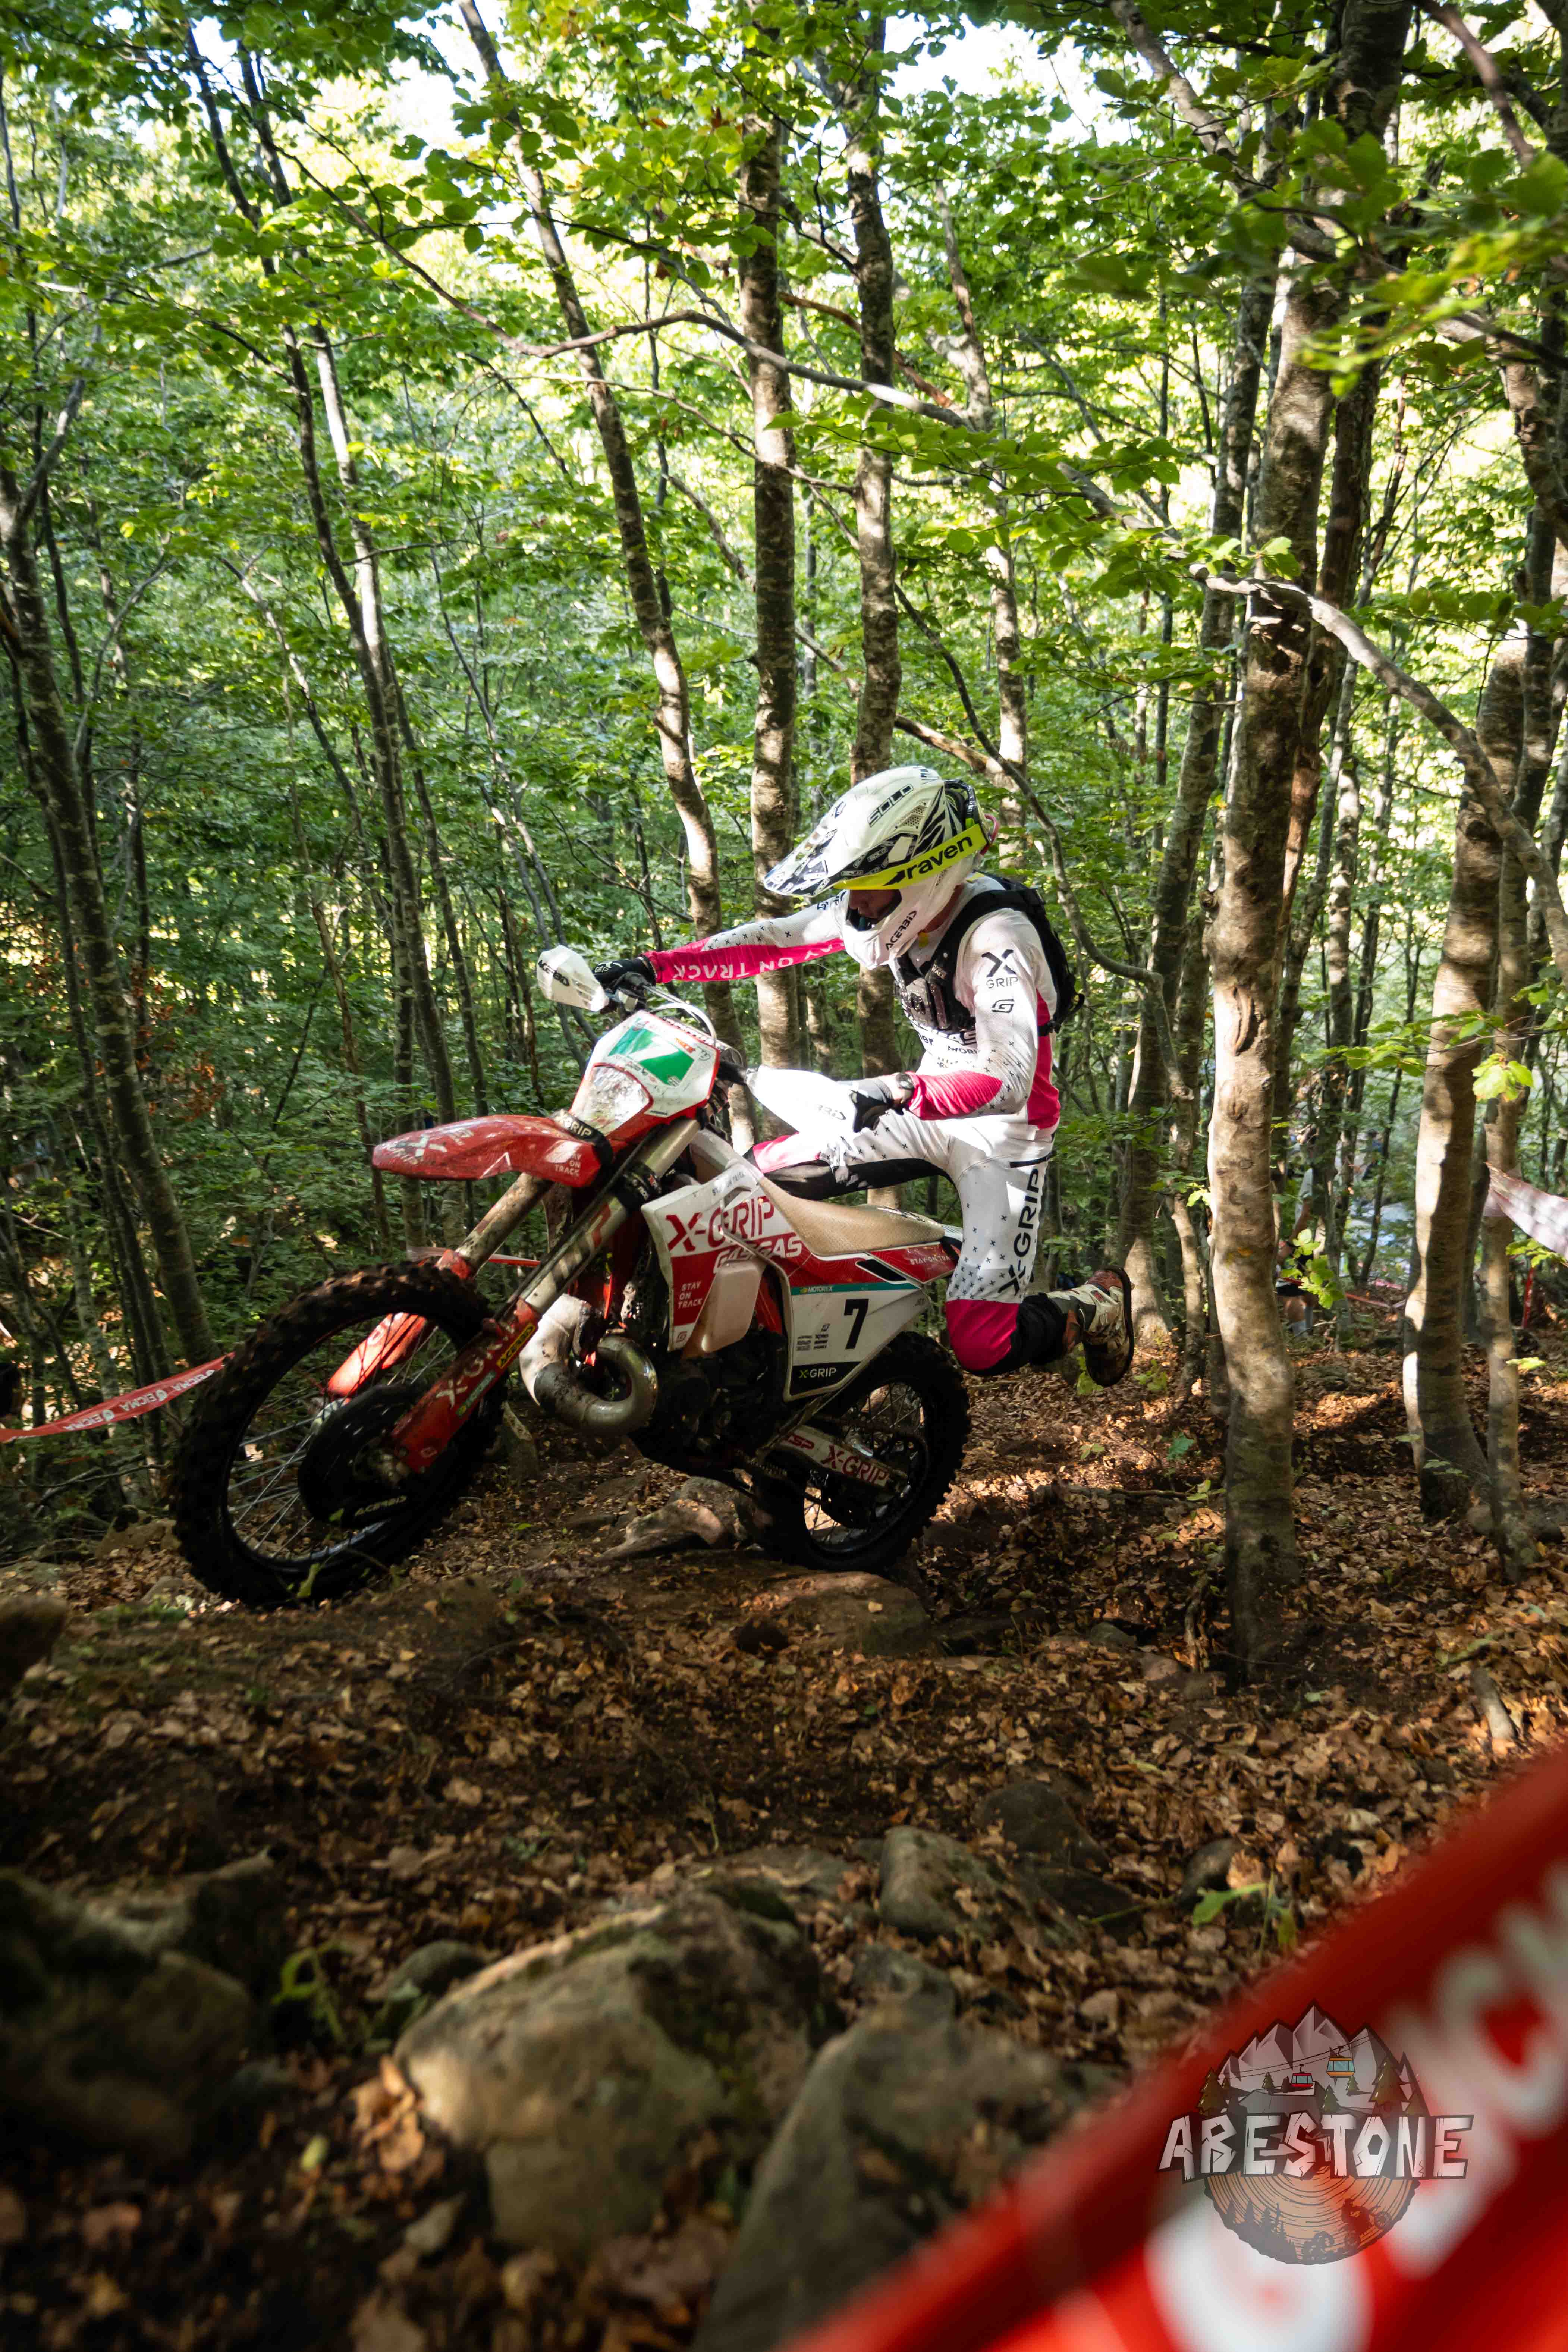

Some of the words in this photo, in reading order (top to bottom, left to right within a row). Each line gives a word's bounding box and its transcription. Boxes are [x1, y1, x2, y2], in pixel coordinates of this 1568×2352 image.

[868, 784, 914, 828] SOLO
[906, 836, 973, 879] raven
[673, 962, 749, 979] TRACK
[760, 957, 794, 974] ON
[986, 977, 1018, 989] GRIP
[555, 1164, 580, 1177] TRACK
[666, 1196, 774, 1252] X-GRIP
[998, 1169, 1039, 1296] X-GRIP
[682, 1281, 701, 1290] STAY
[678, 1298, 702, 1309] TRACK
[844, 1299, 869, 1350] 7
[799, 1367, 837, 1379] X-GRIP
[120, 1394, 159, 1411] EICMA
[821, 1444, 888, 1482] X-GRIP
